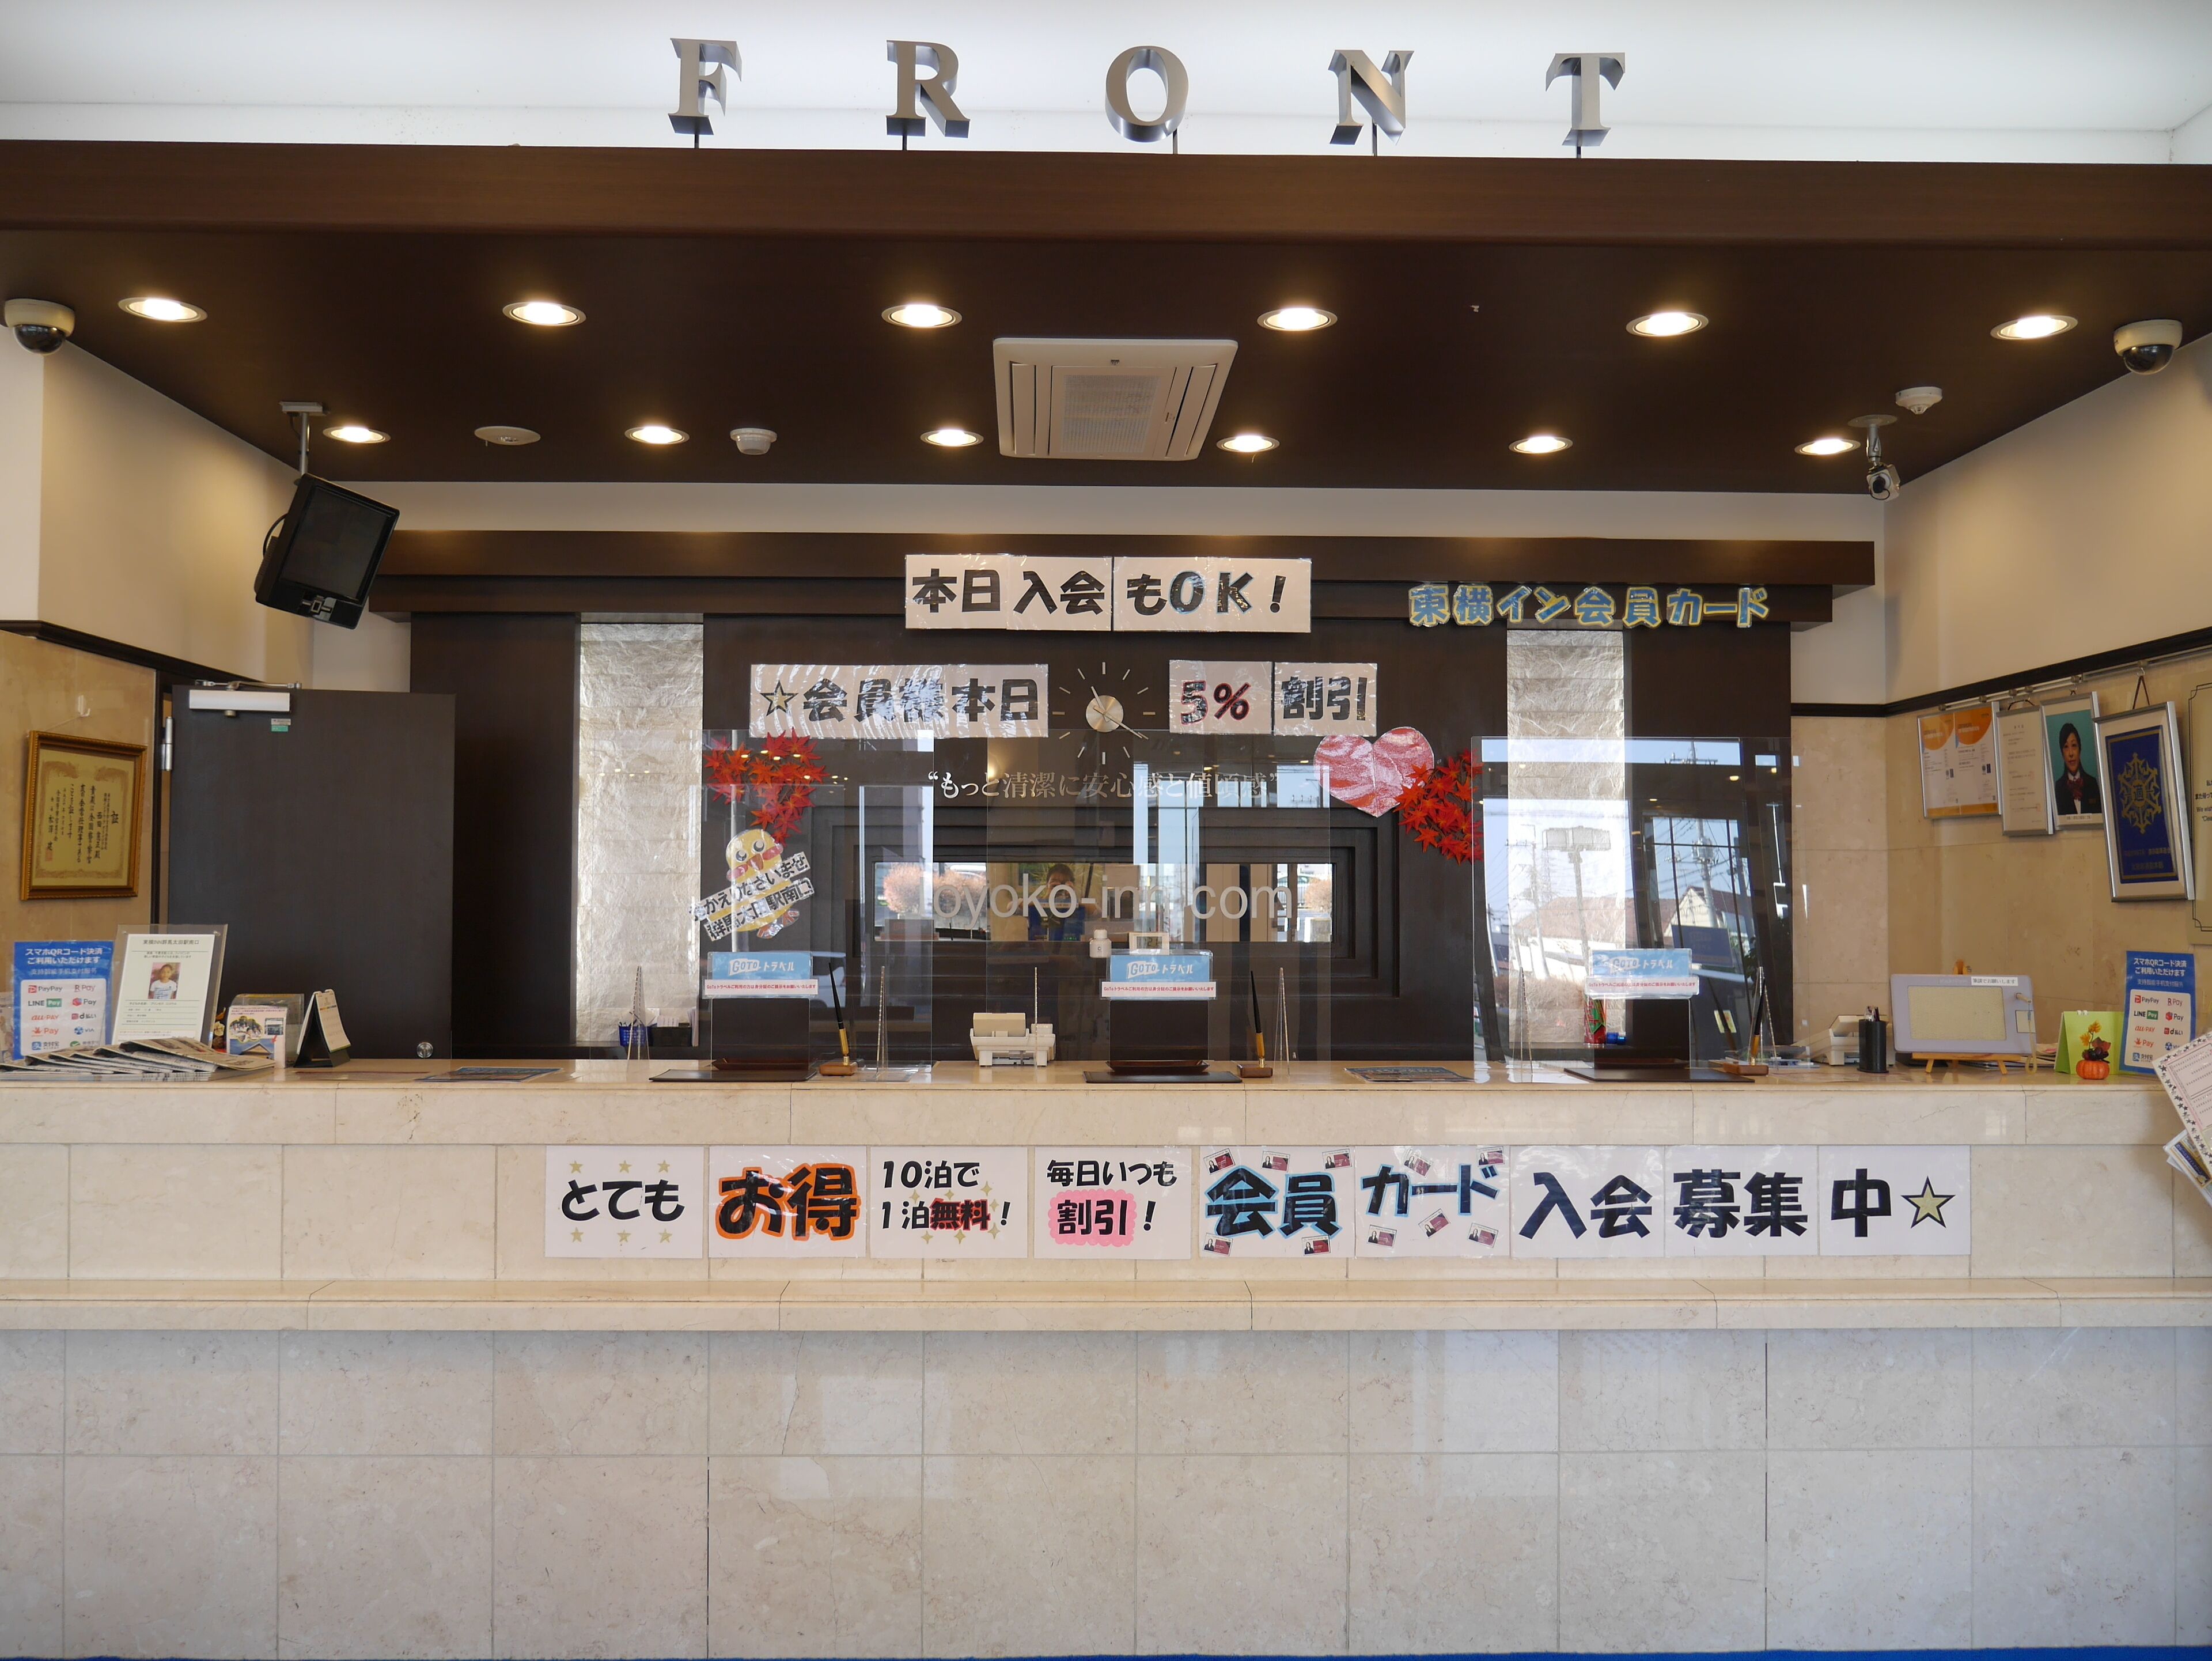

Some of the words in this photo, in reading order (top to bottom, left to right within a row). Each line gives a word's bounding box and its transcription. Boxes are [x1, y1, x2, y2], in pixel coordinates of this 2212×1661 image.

[668, 37, 1626, 146] FRONT
[1410, 584, 1769, 628] 東横イン会員カード
[25, 948, 103, 956] スマホQRコード決済
[27, 956, 101, 964] ご利用いただけます
[2133, 958, 2187, 967] スマホQRコード決済
[764, 961, 794, 972] トラベル
[1162, 964, 1194, 974] トラベル
[2135, 967, 2186, 977] ご利用いただけます
[2142, 996, 2160, 1004] PayPay
[2173, 998, 2183, 1007] Pay
[2173, 1013, 2184, 1021] Pay
[2142, 1039, 2154, 1047] Pay
[881, 1159, 980, 1189] 10泊で
[1047, 1159, 1178, 1187] 毎日いつも
[561, 1178, 685, 1222] とても
[715, 1163, 862, 1241] お得
